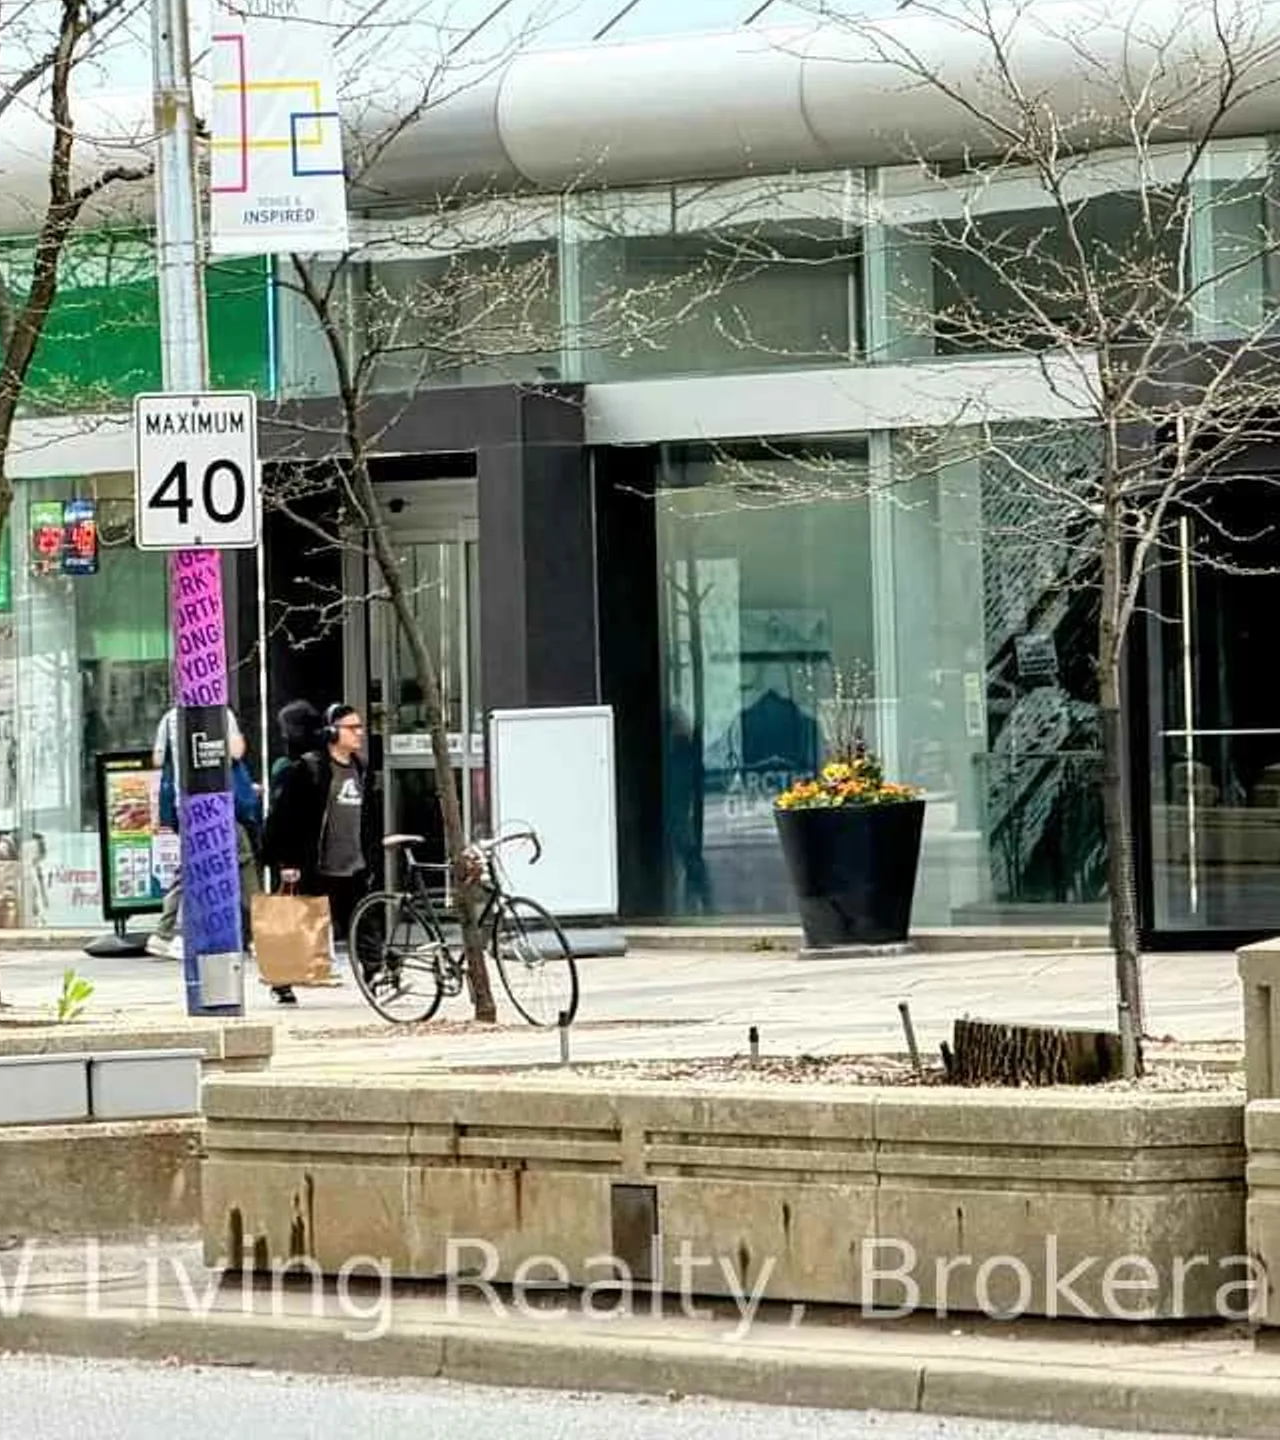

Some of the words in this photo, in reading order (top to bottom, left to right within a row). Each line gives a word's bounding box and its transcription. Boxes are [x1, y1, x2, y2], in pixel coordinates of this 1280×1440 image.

[243, 207, 317, 225] INSPIRED
[146, 410, 245, 436] MAXIMUM
[148, 458, 246, 525] 40
